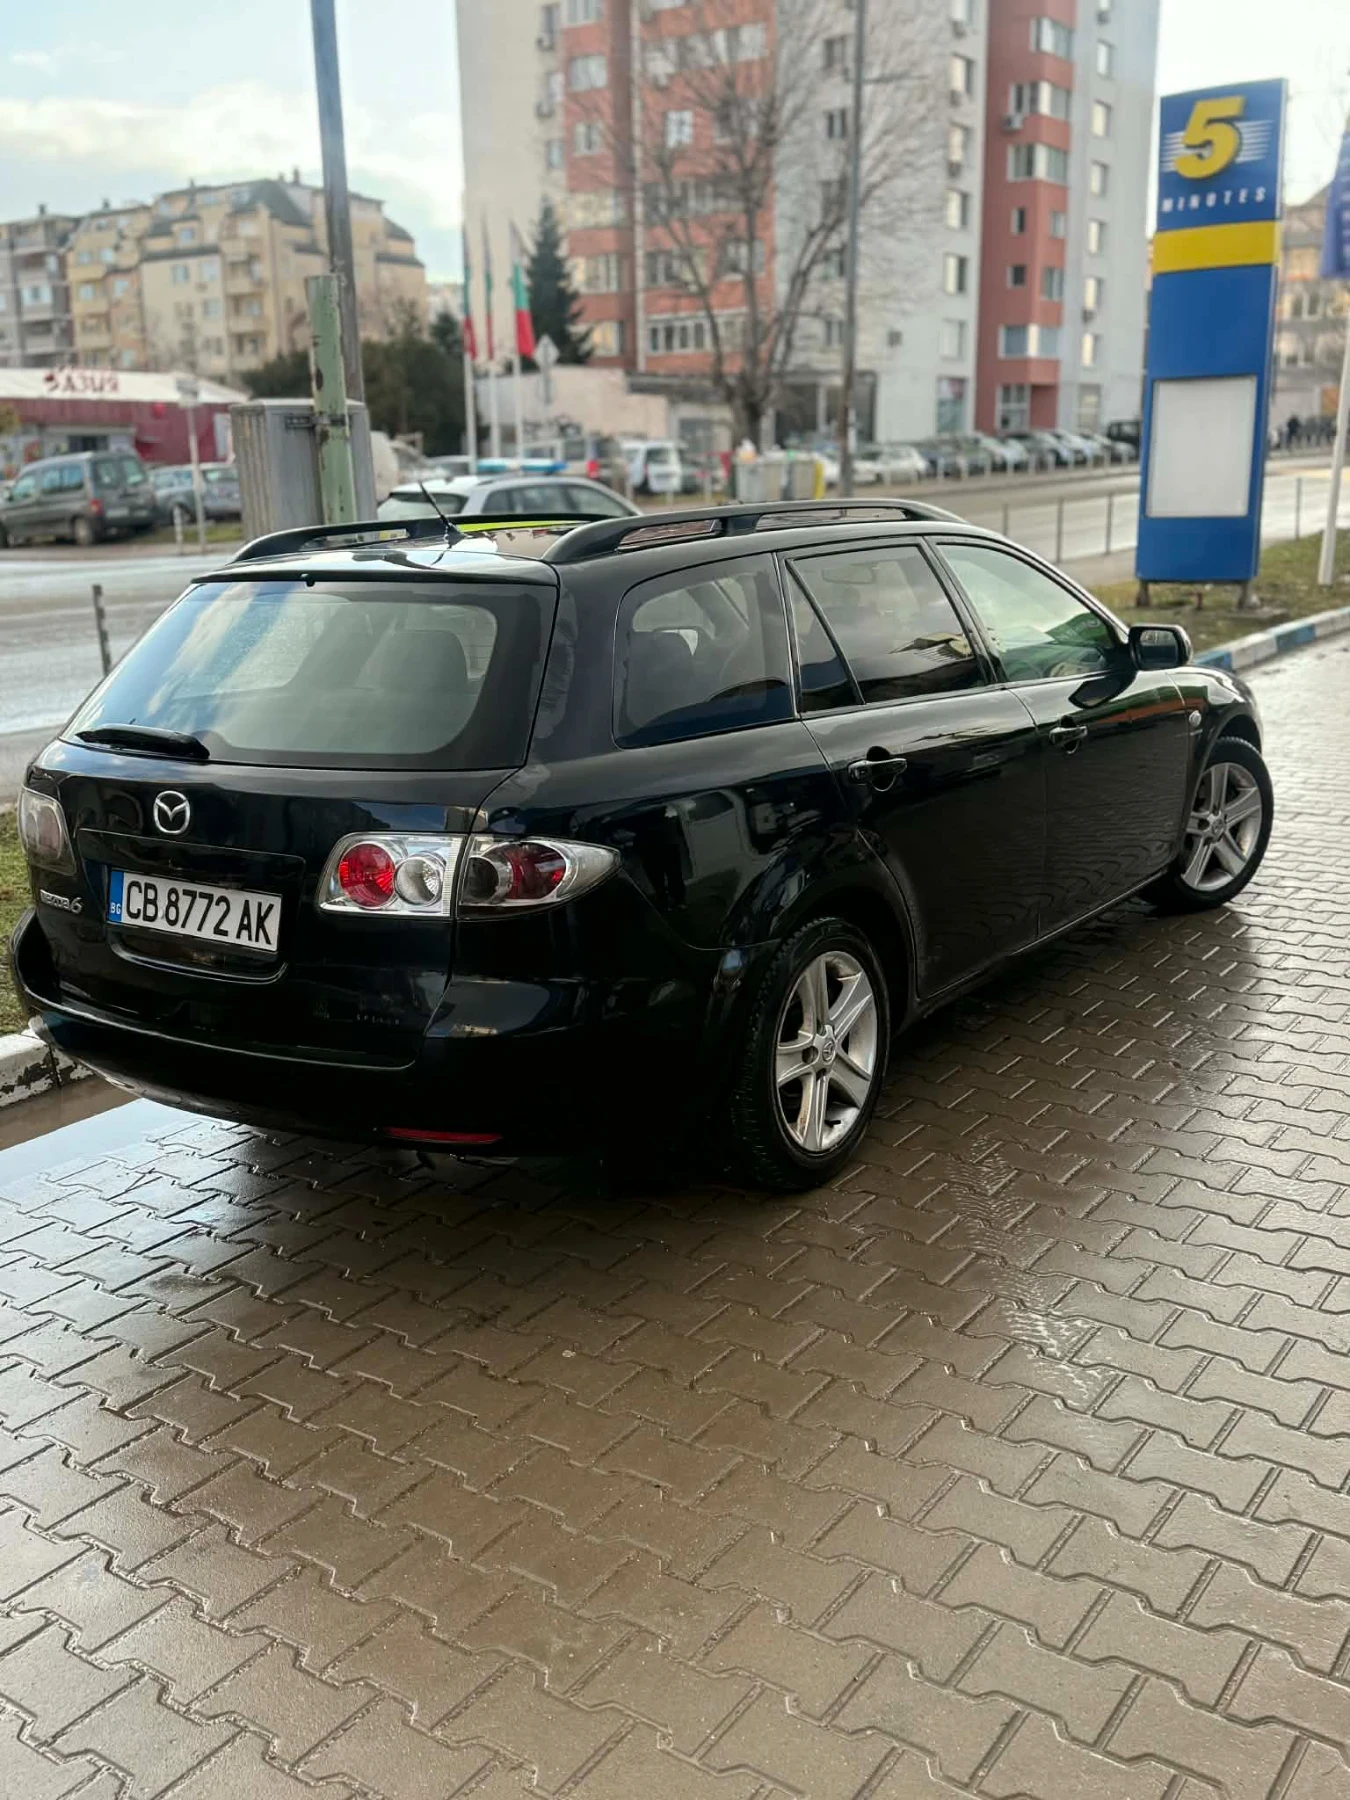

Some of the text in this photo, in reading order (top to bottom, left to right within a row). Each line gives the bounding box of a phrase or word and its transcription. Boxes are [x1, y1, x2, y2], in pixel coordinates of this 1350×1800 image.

[1175, 95, 1245, 179] 5
[109, 901, 122, 915] BG
[126, 880, 275, 946] CB 8772 AK
